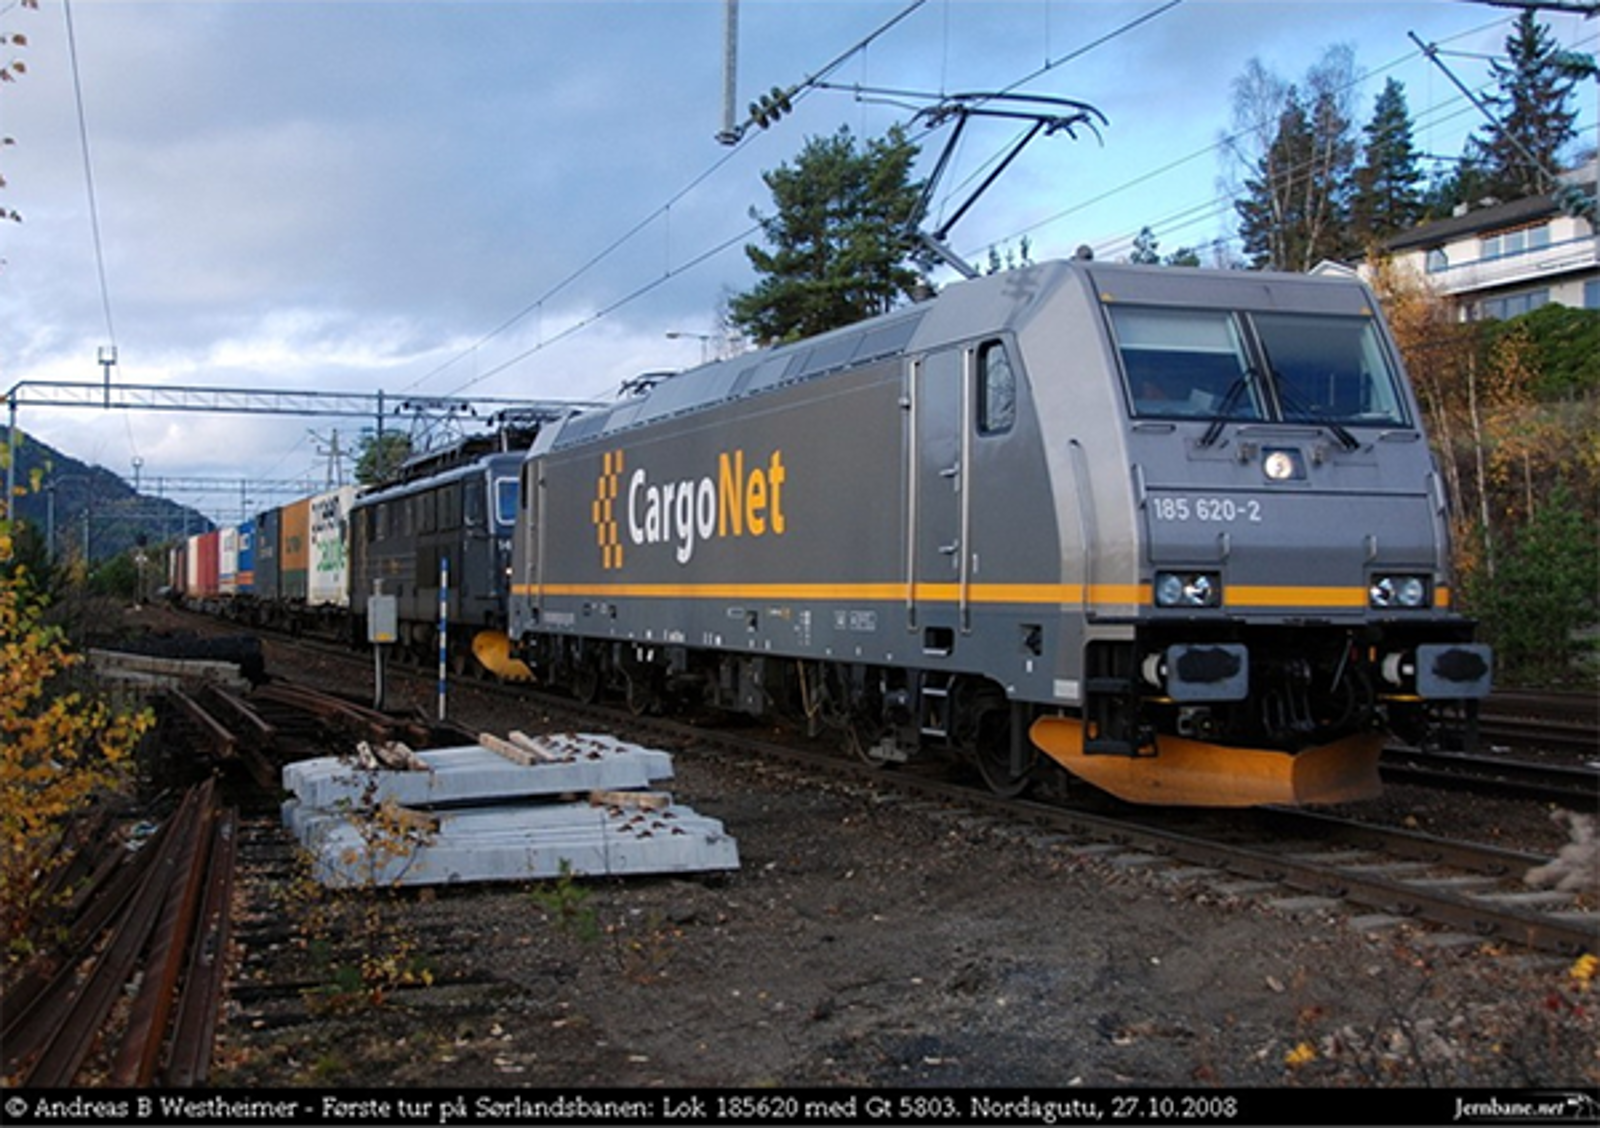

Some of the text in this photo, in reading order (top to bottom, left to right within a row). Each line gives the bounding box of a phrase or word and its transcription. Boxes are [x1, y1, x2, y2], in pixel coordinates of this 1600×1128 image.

[628, 449, 785, 564] CargoNet
[1154, 498, 1262, 521] 185 620-2
